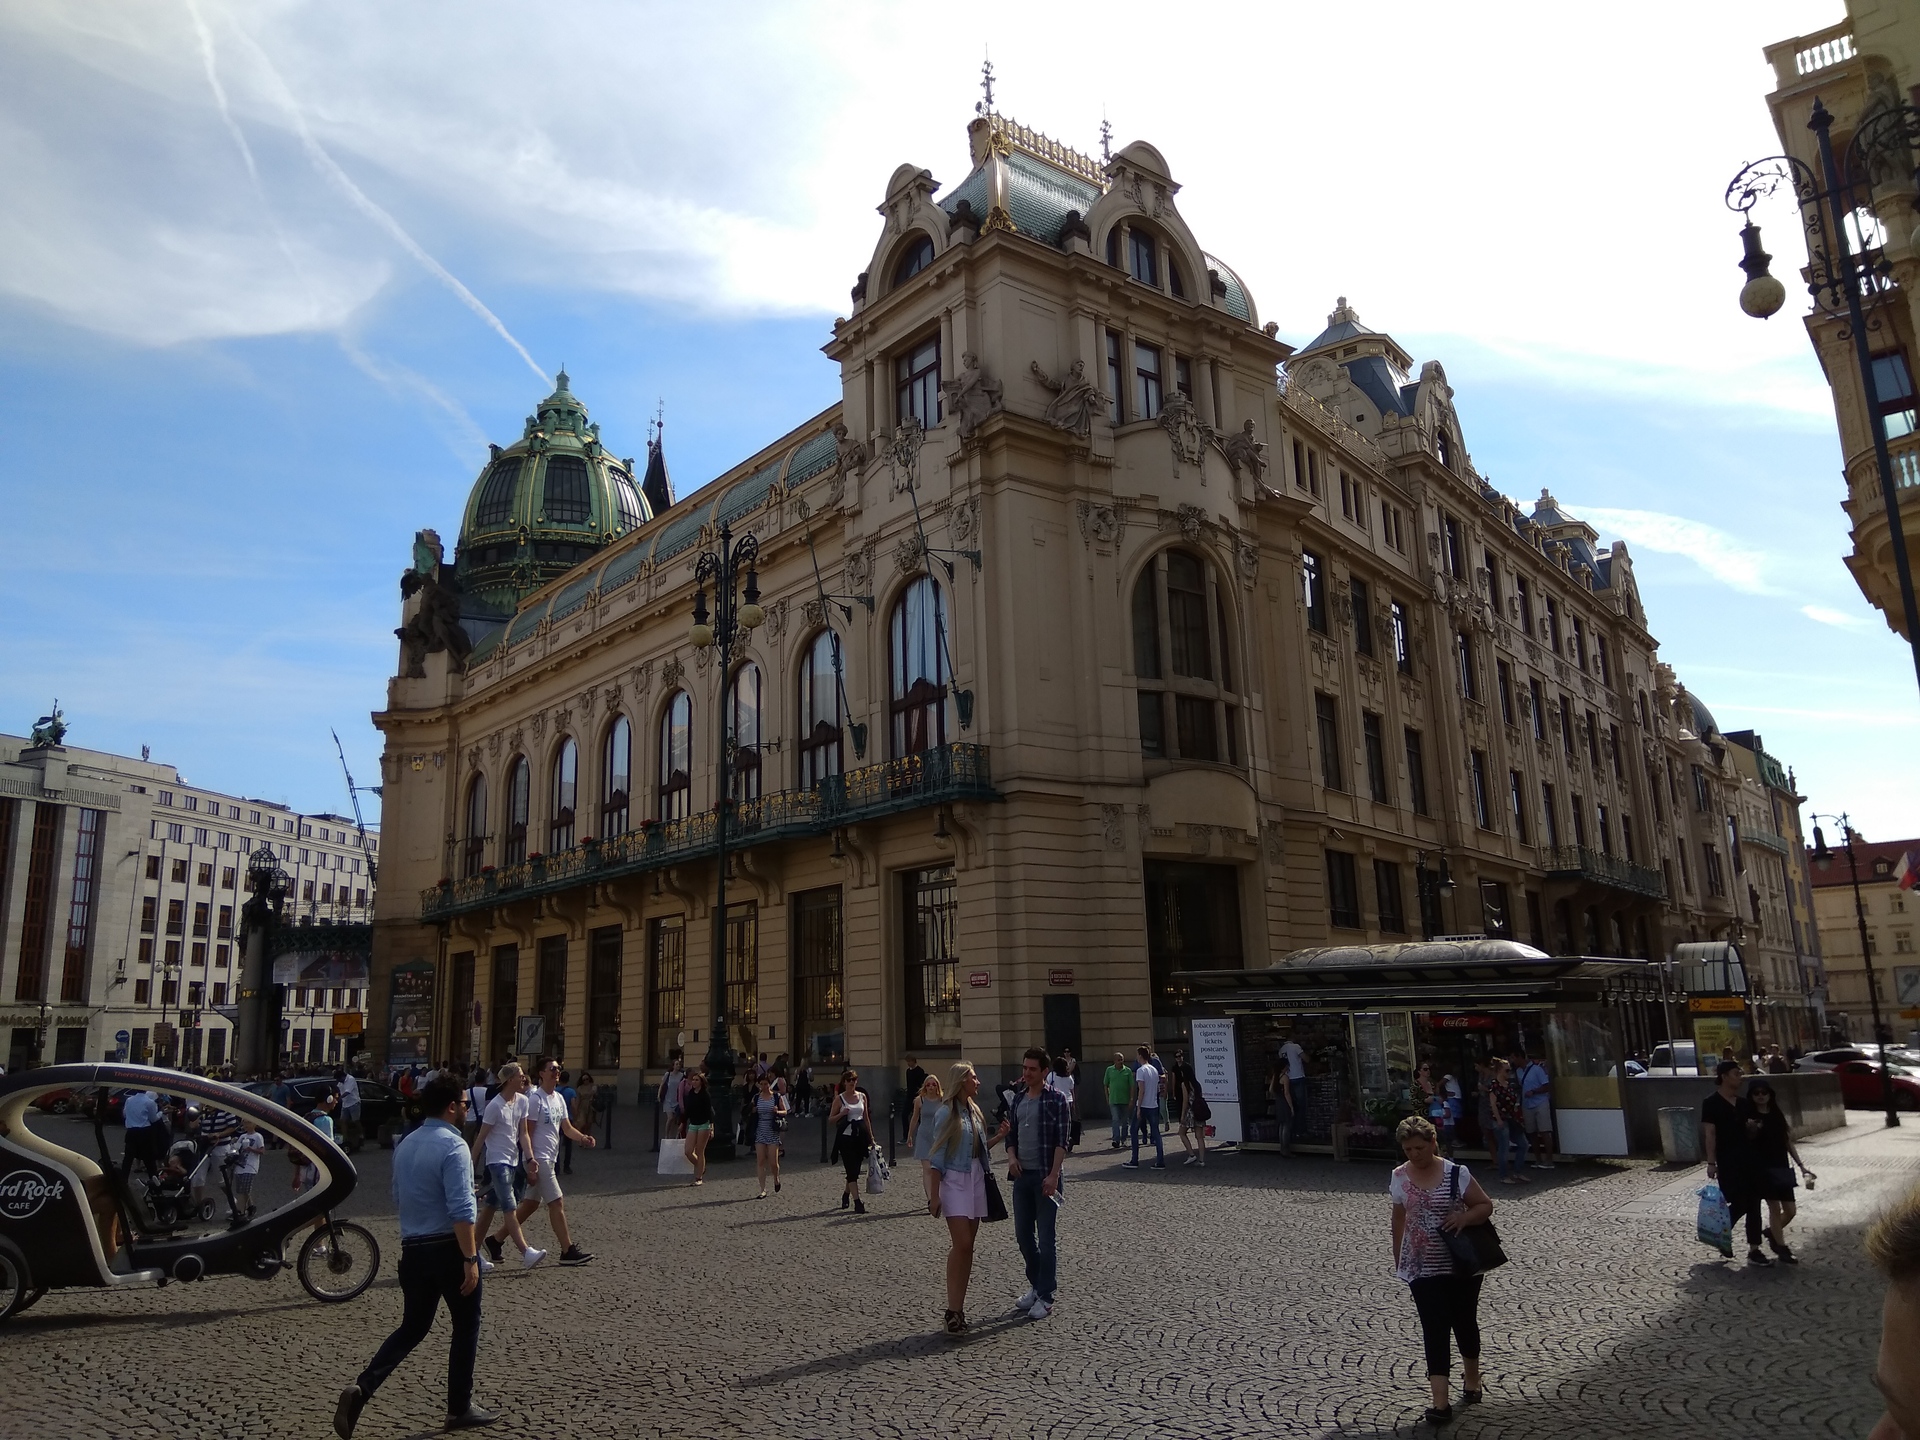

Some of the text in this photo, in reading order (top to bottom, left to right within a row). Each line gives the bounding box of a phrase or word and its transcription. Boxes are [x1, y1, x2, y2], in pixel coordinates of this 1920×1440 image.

[1265, 1000, 1322, 1008] tobacco shop
[151, 1075, 177, 1083] greater
[178, 1080, 200, 1088] salute
[244, 1100, 267, 1114] history
[0, 1180, 65, 1200] rd Rock
[8, 1202, 31, 1210] CAFE
